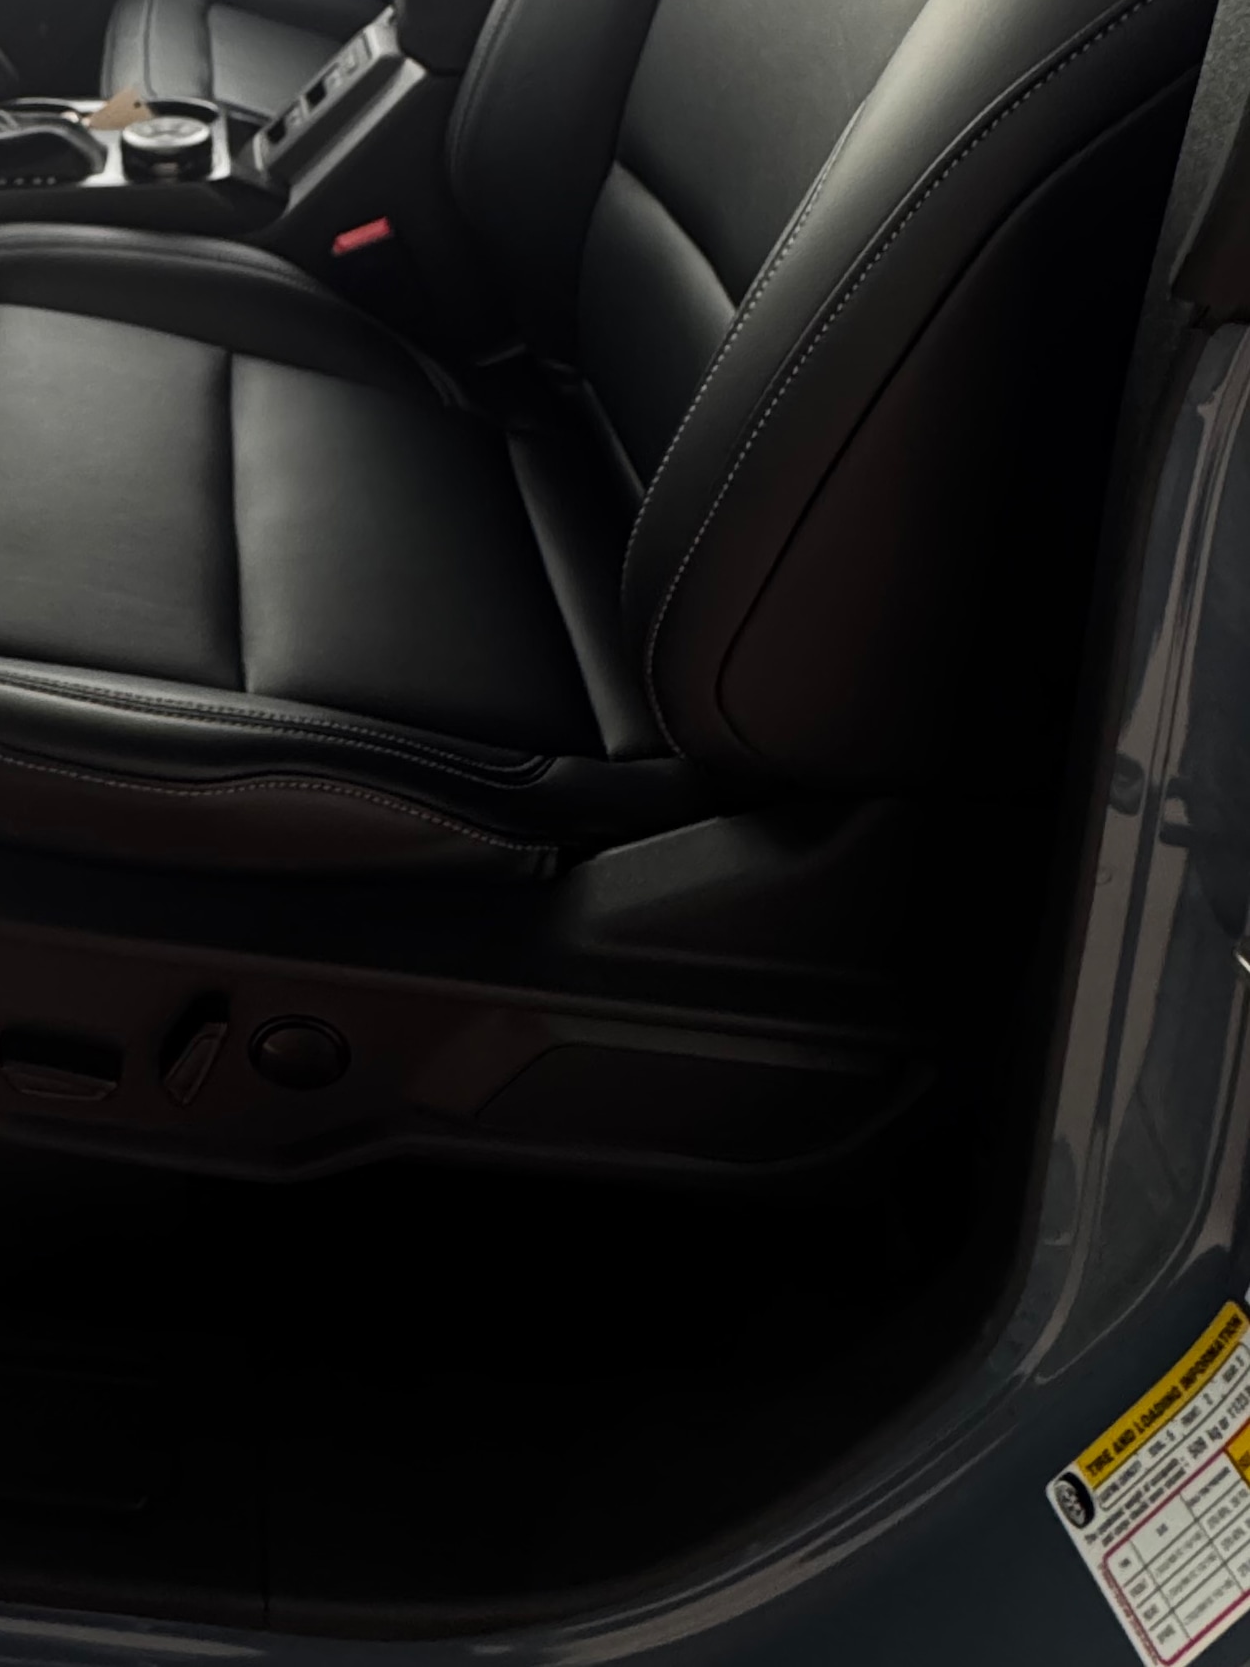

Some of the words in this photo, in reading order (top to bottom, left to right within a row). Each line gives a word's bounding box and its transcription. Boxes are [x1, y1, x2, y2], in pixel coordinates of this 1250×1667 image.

[1085, 1448, 1115, 1477] TIRE
[1112, 1428, 1137, 1455] AND
[1133, 1385, 1183, 1435] LOADING
[1179, 1313, 1244, 1391] INFORMATION
